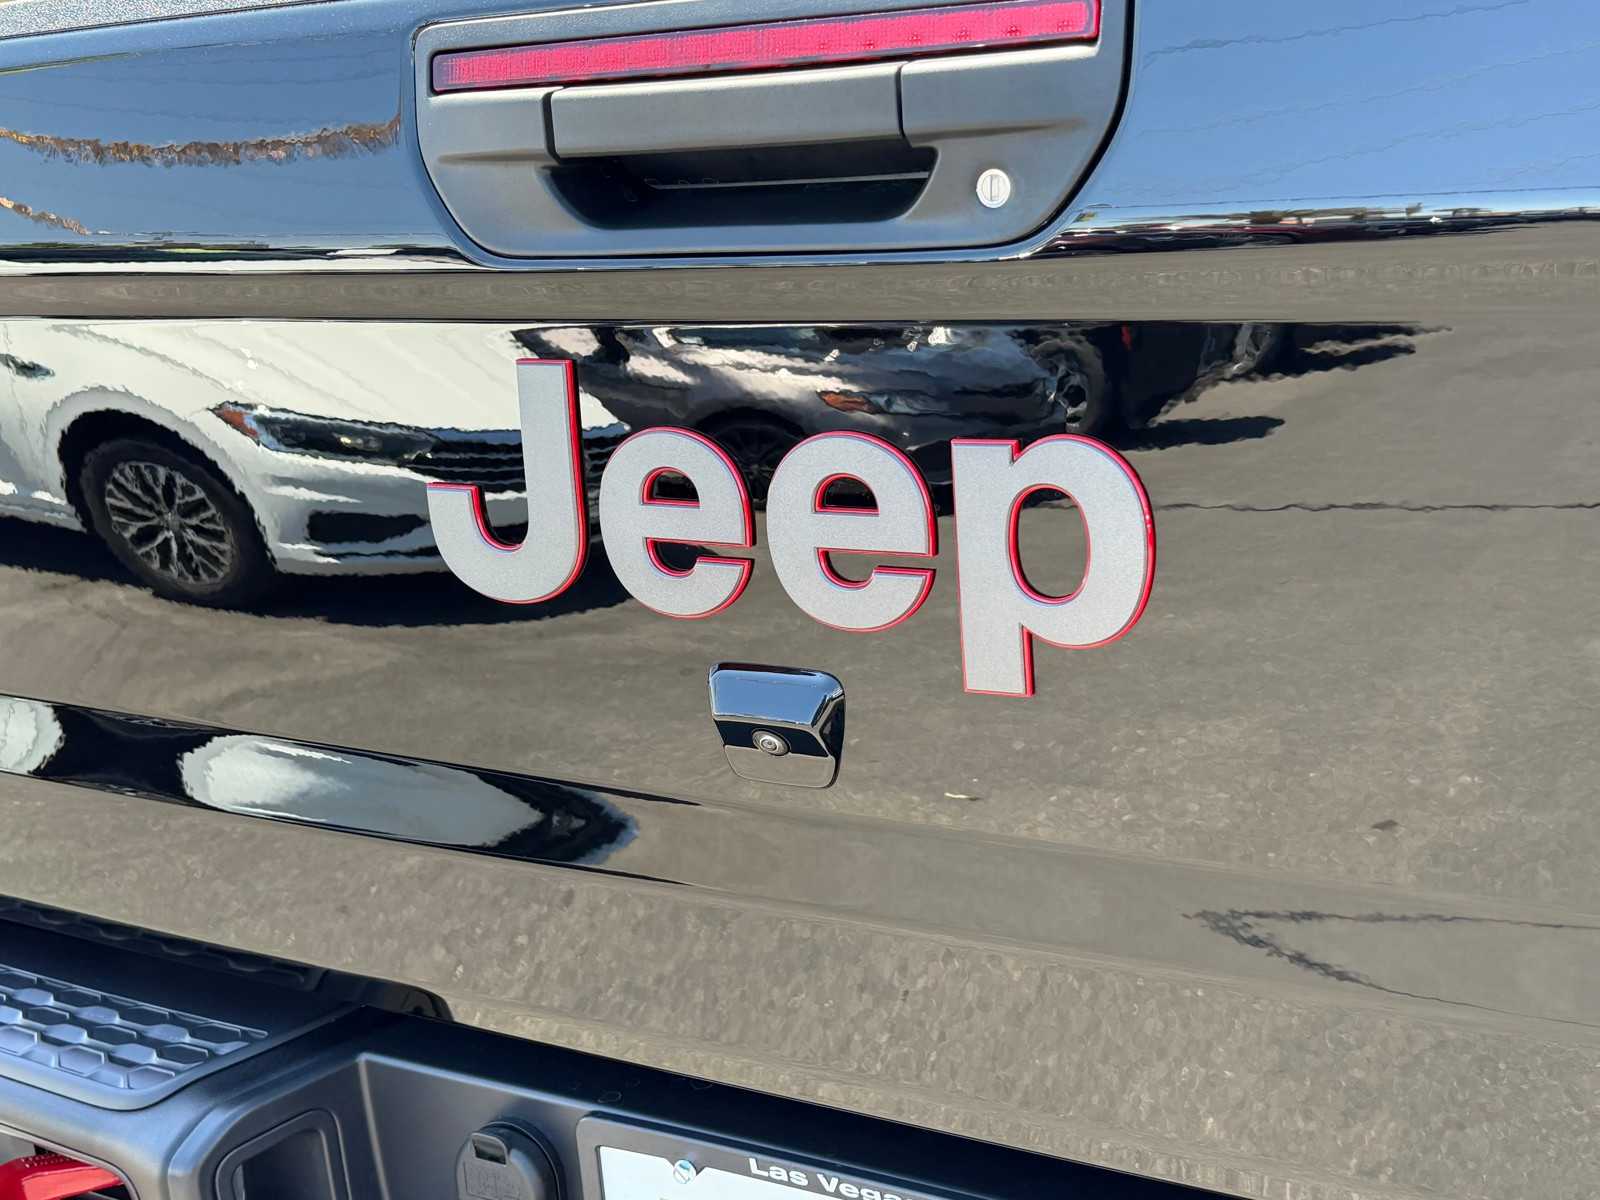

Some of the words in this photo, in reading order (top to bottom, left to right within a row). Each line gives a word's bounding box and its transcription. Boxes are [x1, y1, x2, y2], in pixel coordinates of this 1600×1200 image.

[427, 358, 1157, 696] Jeep
[749, 1158, 809, 1186] Las
[816, 1173, 913, 1200] Veg
